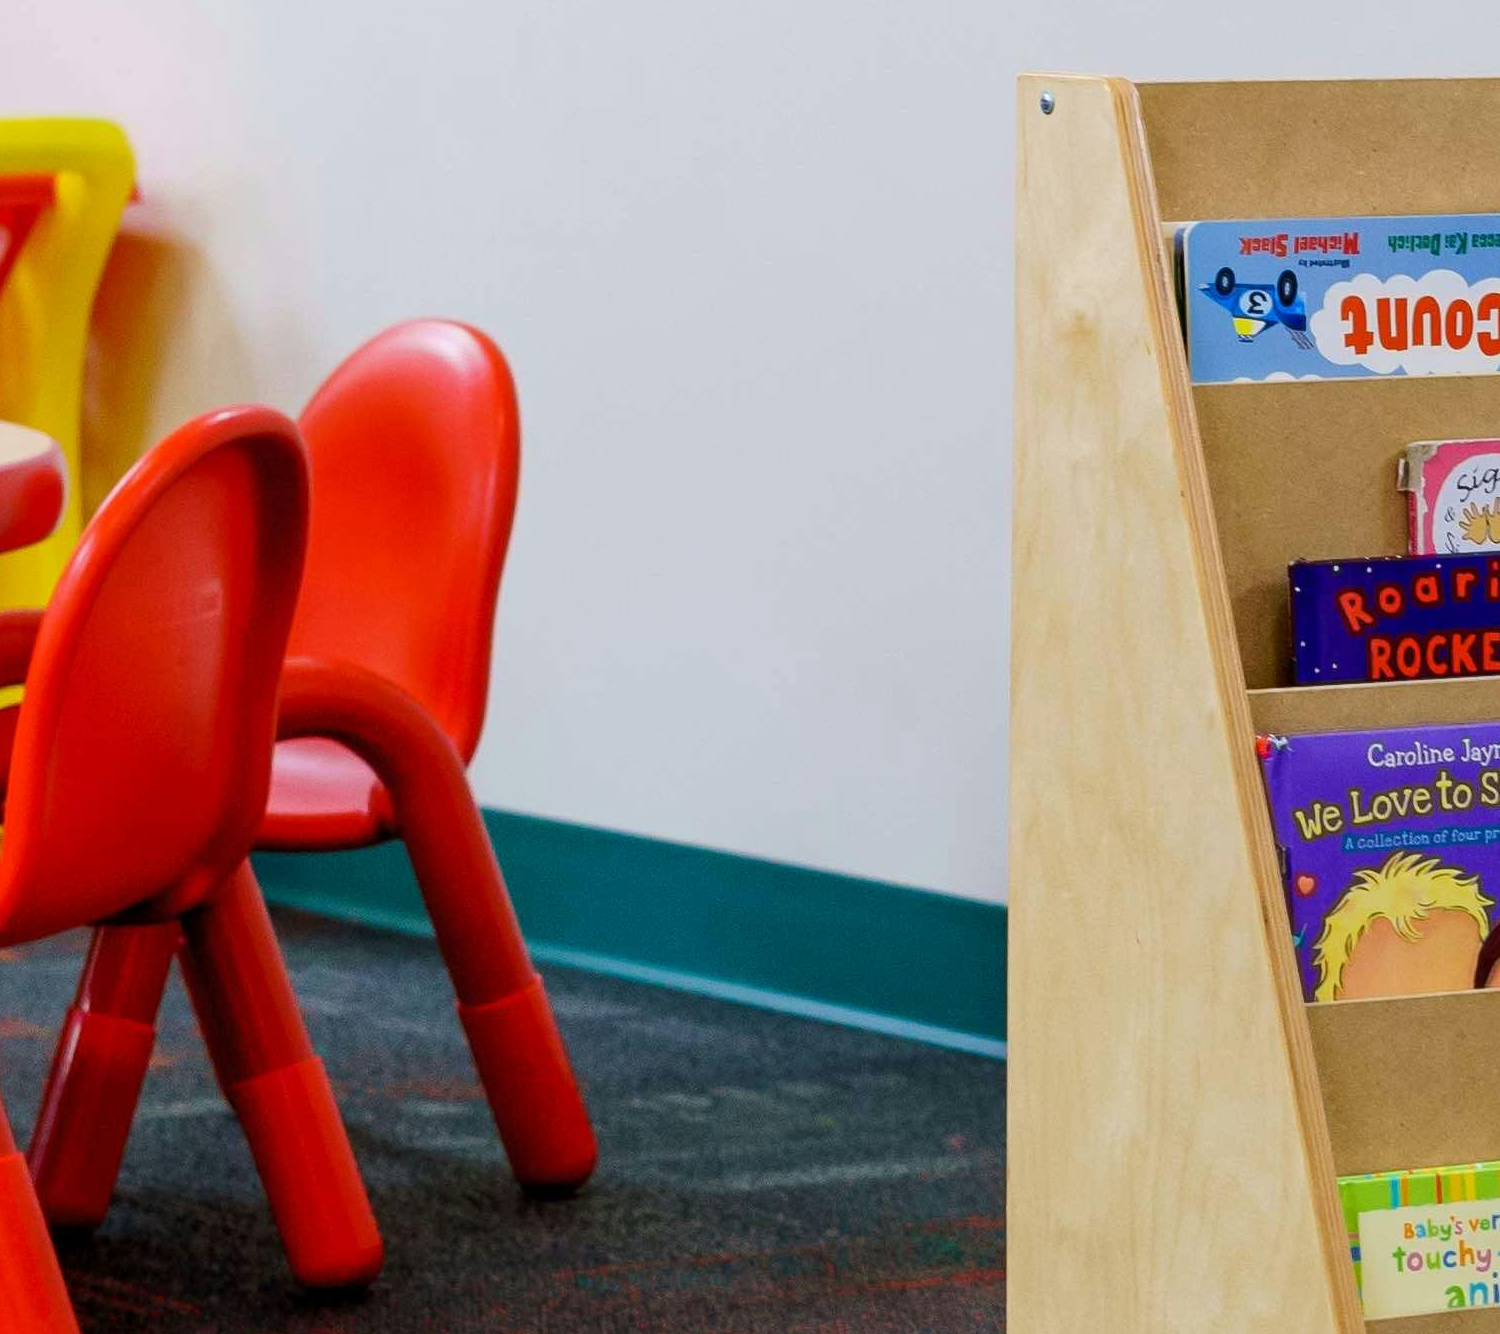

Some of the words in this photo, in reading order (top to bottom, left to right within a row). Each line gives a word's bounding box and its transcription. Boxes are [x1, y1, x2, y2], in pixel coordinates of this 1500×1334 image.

[1238, 234, 1288, 257] Slack
[1294, 232, 1360, 255] Michael
[1445, 232, 1467, 253] Kai
[1247, 291, 1268, 314] 3
[1367, 740, 1455, 768] Caroline
[1295, 801, 1344, 841] We
[1349, 786, 1432, 824] Love
[1435, 770, 1472, 811] to
[1344, 837, 1355, 850] A
[1357, 832, 1430, 849] collection
[1433, 830, 1448, 844] of
[1451, 828, 1481, 842] four
[1403, 1215, 1464, 1242] Baby's
